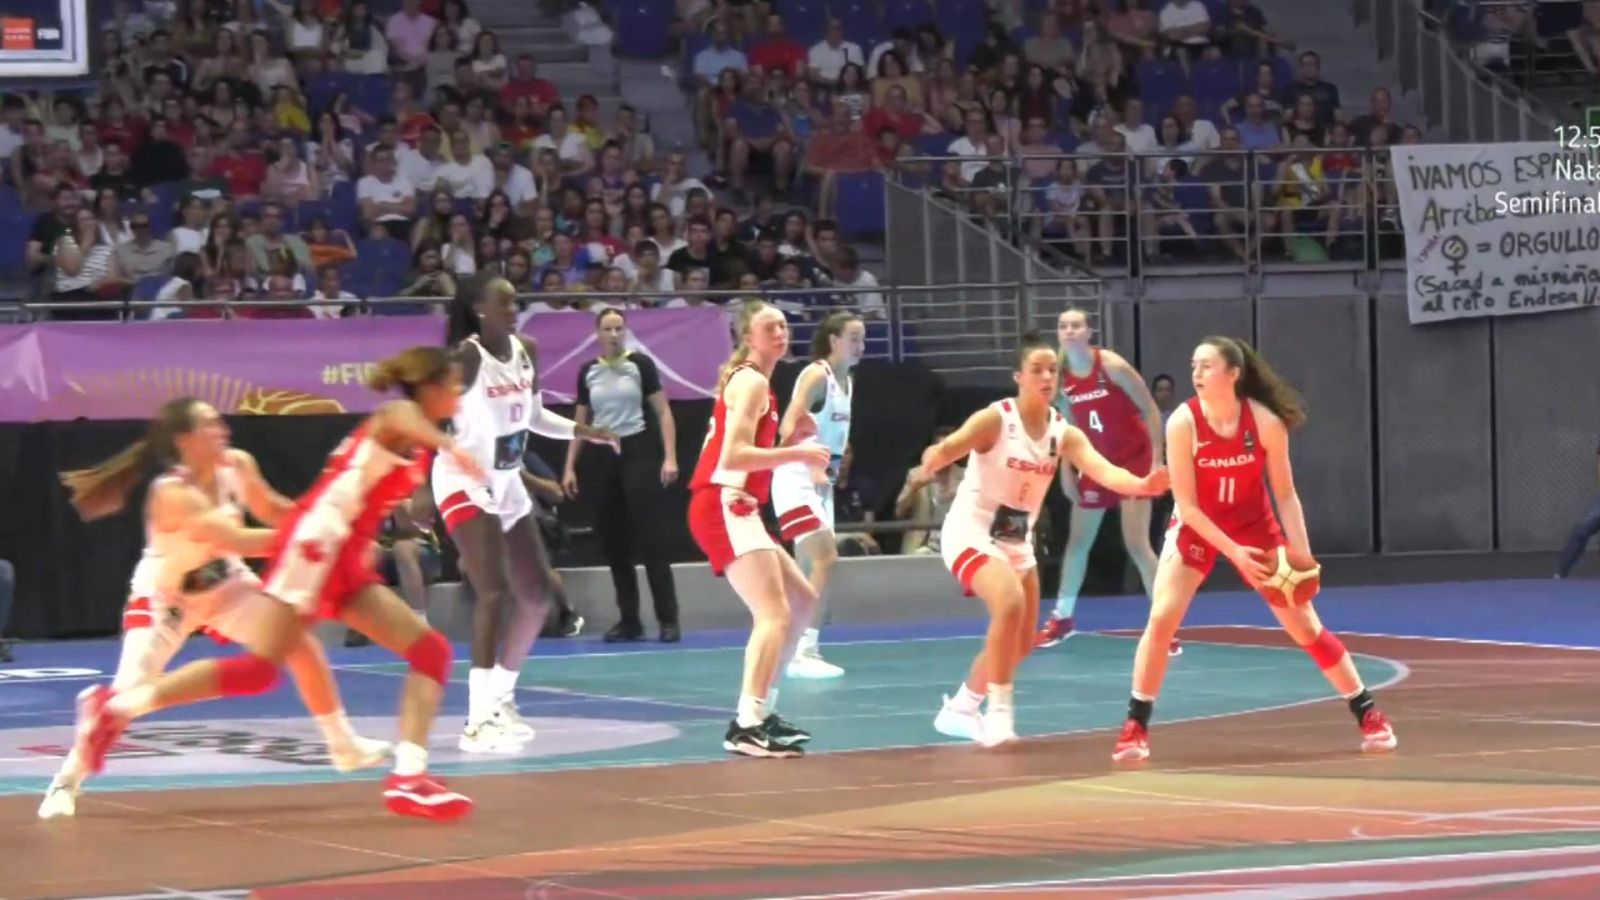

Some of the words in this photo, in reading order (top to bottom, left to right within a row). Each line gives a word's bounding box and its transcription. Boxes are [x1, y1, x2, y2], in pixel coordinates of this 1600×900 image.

[1501, 226, 1599, 258] ORGULLO
[1089, 410, 1104, 433] 4
[1197, 454, 1256, 468] CANADA
[1218, 476, 1236, 503] 11
